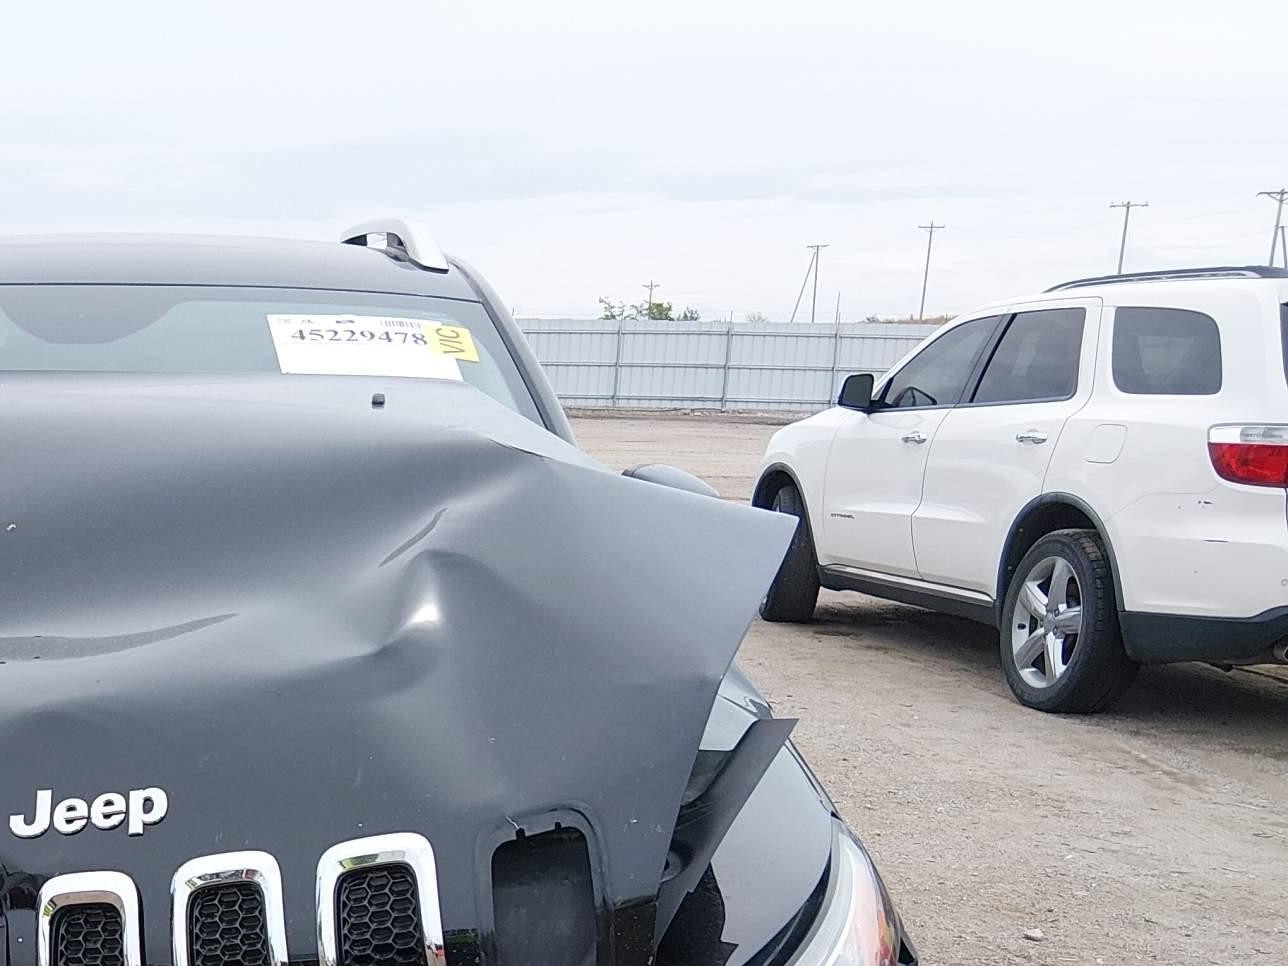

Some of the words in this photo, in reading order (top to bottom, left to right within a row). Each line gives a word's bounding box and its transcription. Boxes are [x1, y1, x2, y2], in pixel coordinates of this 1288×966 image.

[291, 328, 428, 346] 45229478
[435, 327, 466, 355] VIC
[9, 787, 168, 838] Jeep
